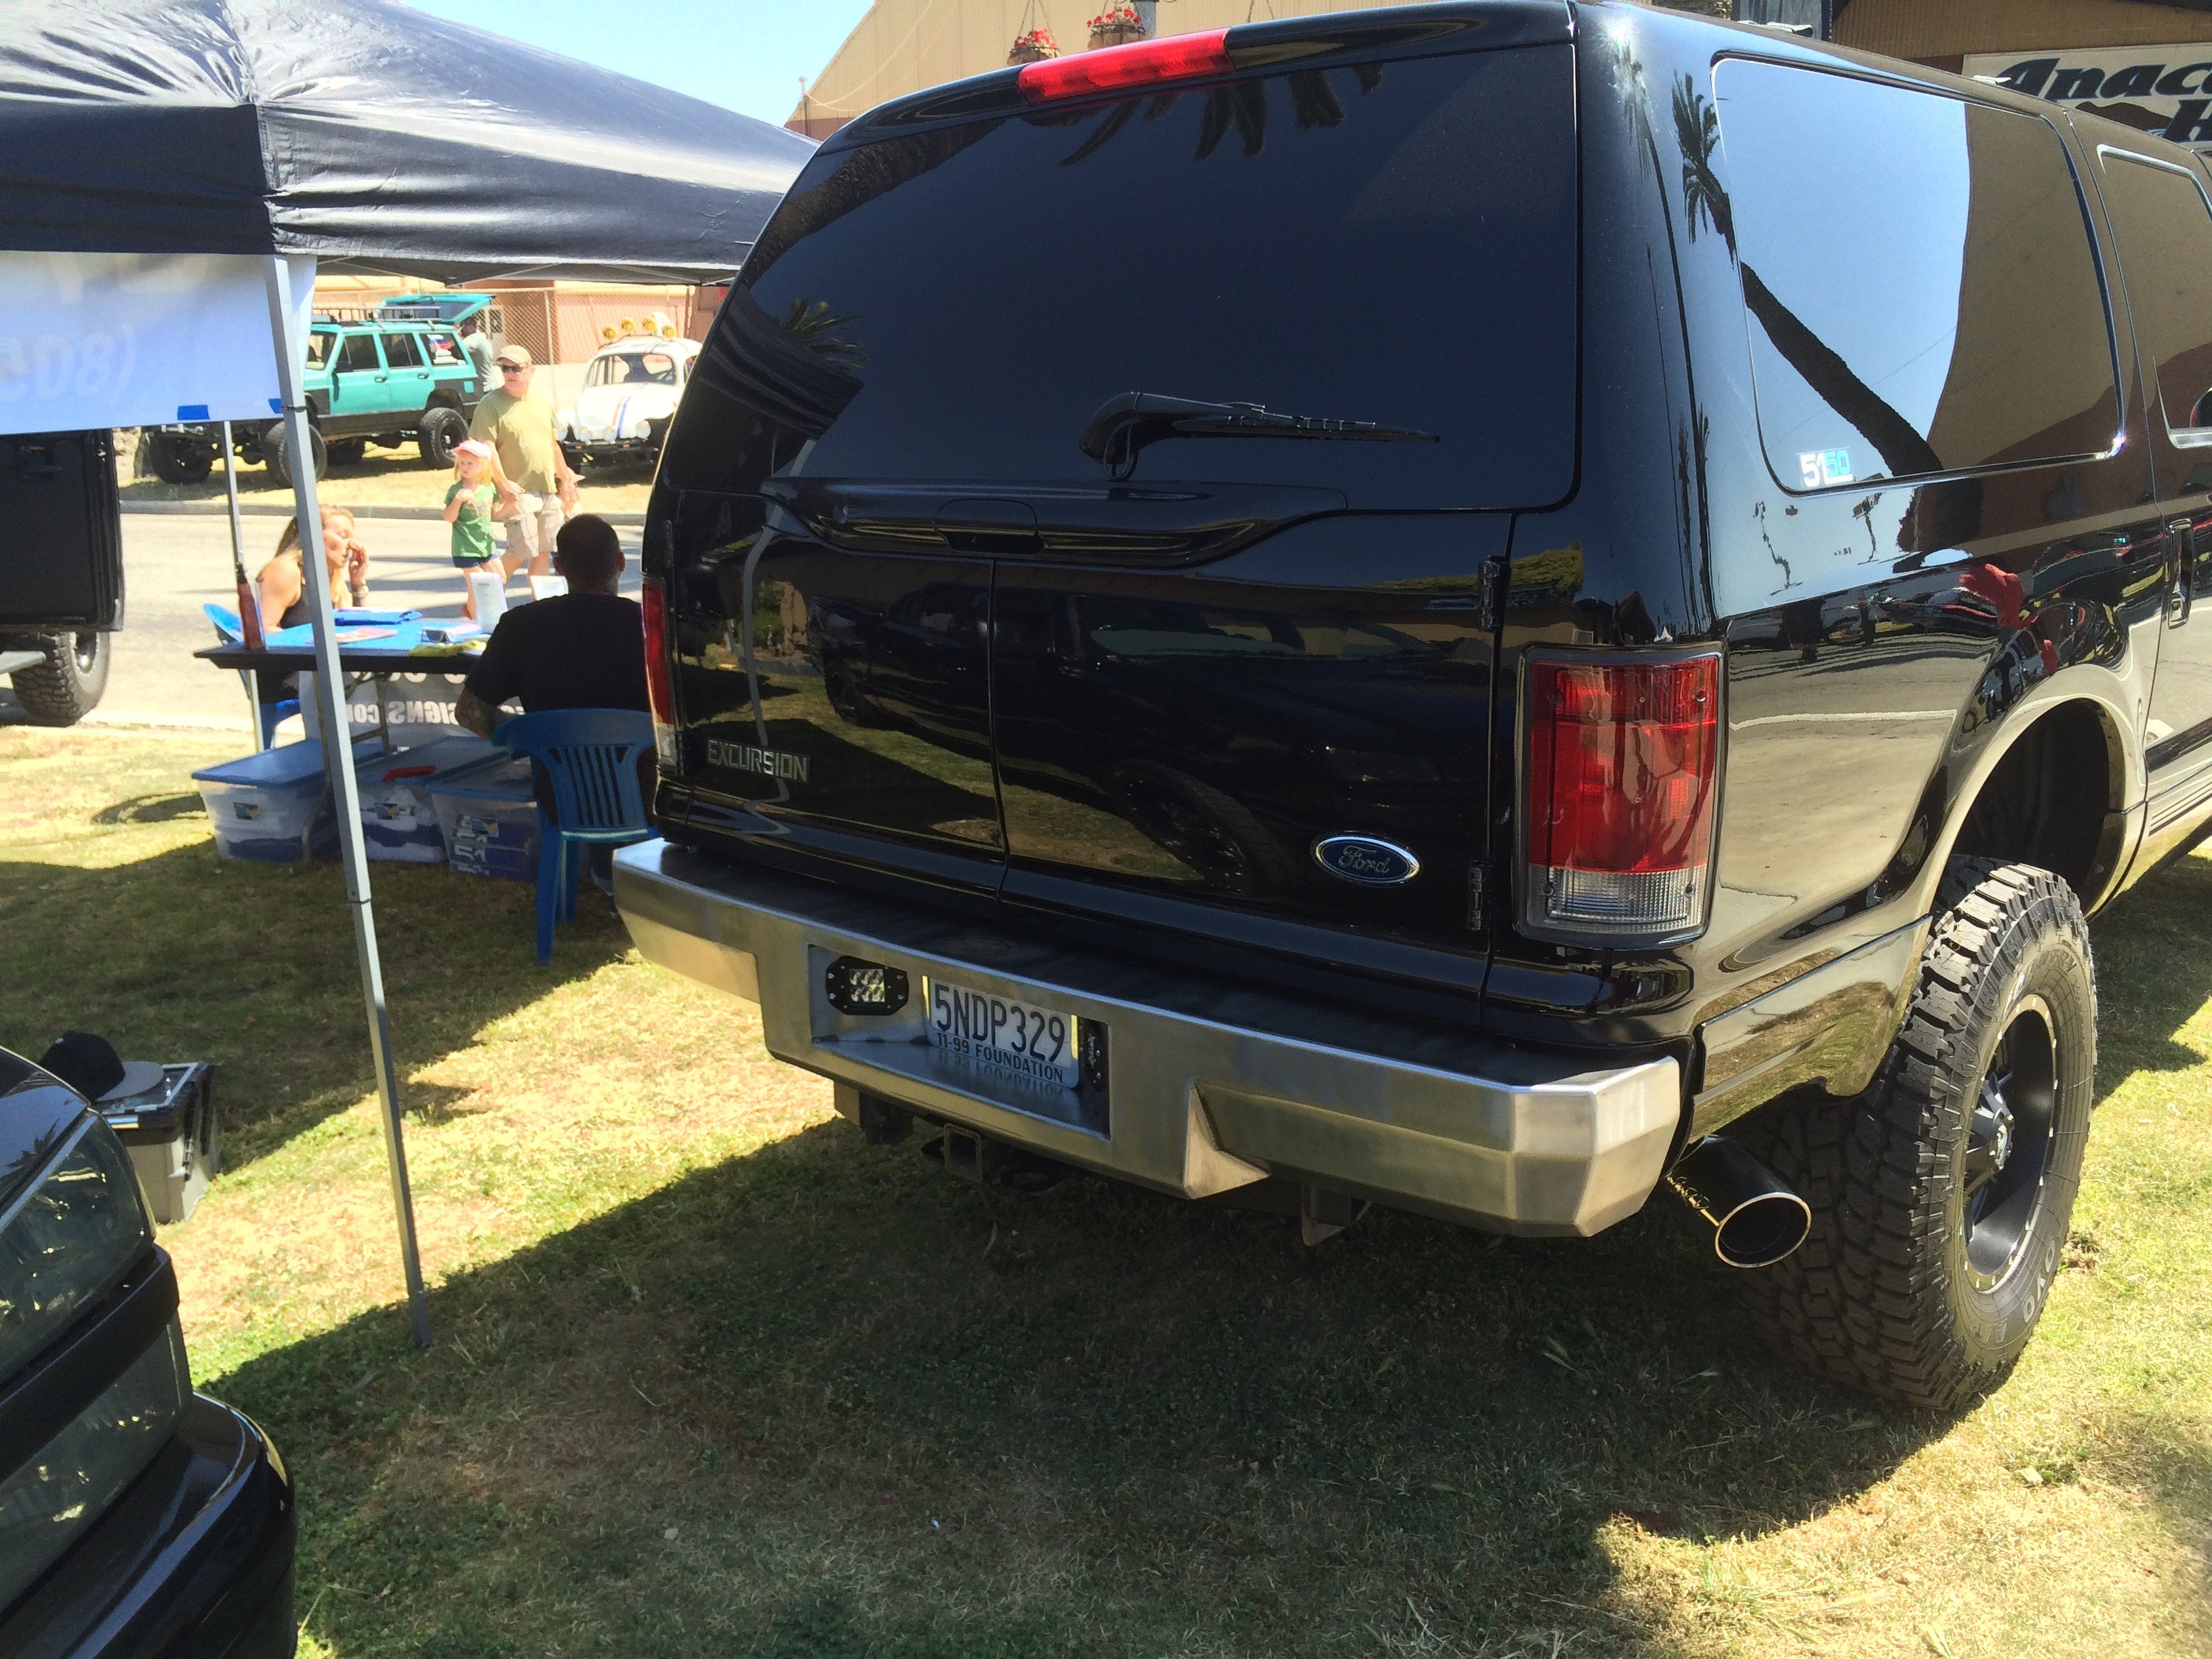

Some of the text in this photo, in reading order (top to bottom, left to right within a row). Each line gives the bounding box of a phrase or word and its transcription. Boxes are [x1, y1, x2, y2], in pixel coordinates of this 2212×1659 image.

[1996, 58, 2212, 102] Anac
[1799, 450, 1851, 487] 5150
[708, 739, 808, 781] EXCURSION
[1338, 845, 1391, 874] Ford
[935, 983, 1065, 1063] 5NDP329
[937, 1032, 970, 1054] 11-99
[976, 1043, 1063, 1084] FOUNDATION
